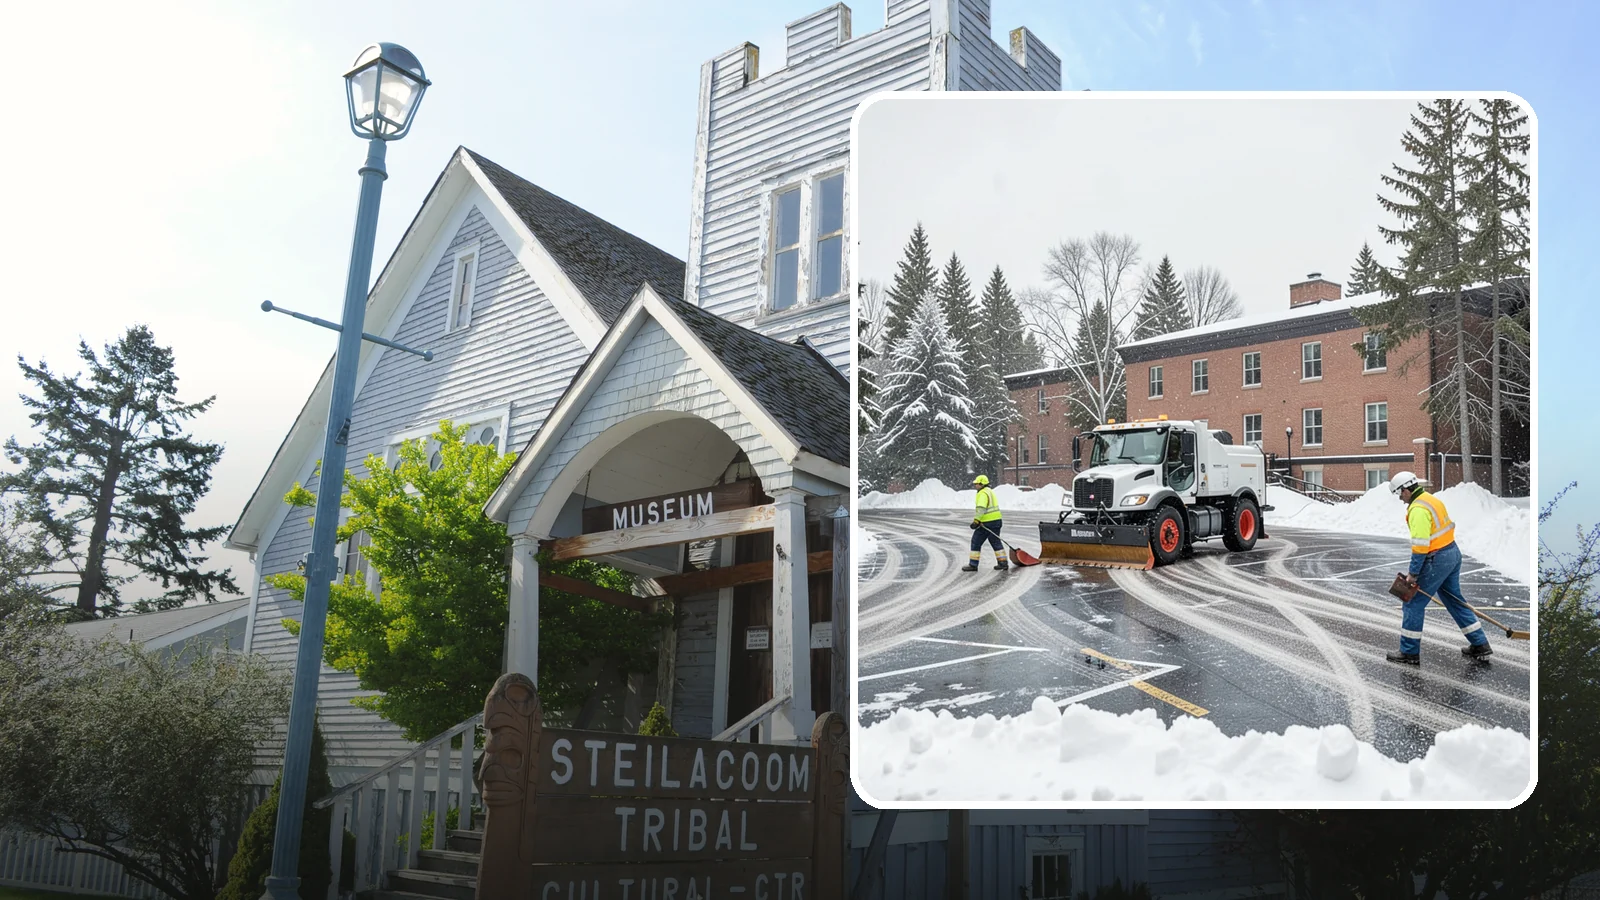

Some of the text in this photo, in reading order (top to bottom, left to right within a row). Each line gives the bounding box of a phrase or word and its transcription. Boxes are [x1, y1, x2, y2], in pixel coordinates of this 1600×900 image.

[612, 491, 713, 531] MUSEUM
[550, 738, 809, 792] STEILACOOM
[614, 806, 757, 851] TRIBAL
